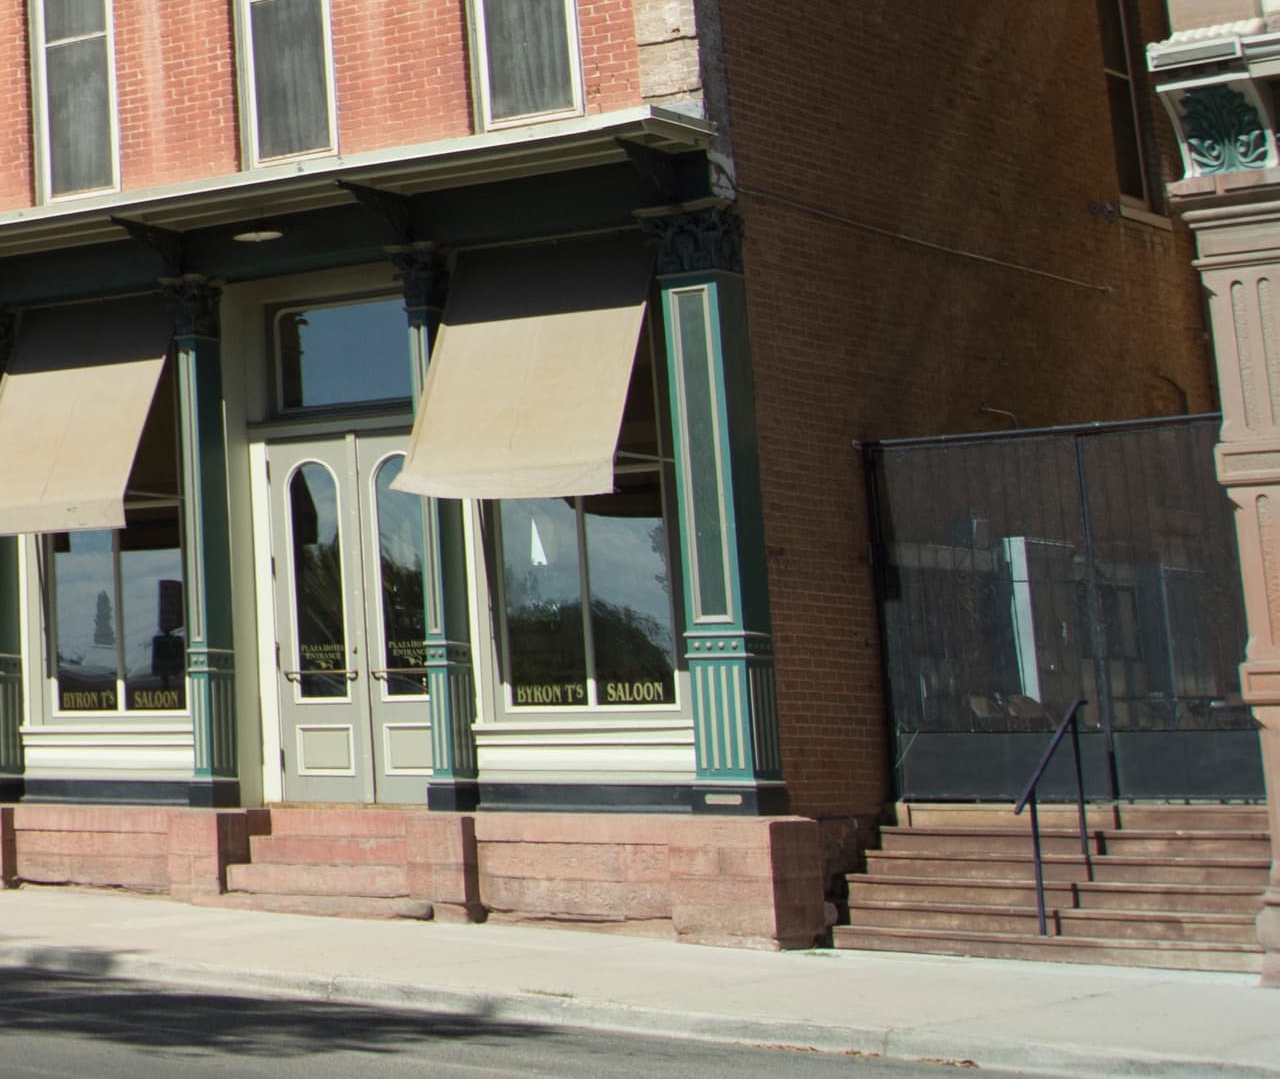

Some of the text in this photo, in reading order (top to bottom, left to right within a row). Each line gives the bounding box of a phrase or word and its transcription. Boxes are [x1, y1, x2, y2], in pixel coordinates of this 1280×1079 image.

[63, 692, 98, 708] BYRON
[134, 690, 179, 708] SALOON
[516, 684, 562, 703] BYRON
[607, 682, 664, 701] SALOON
